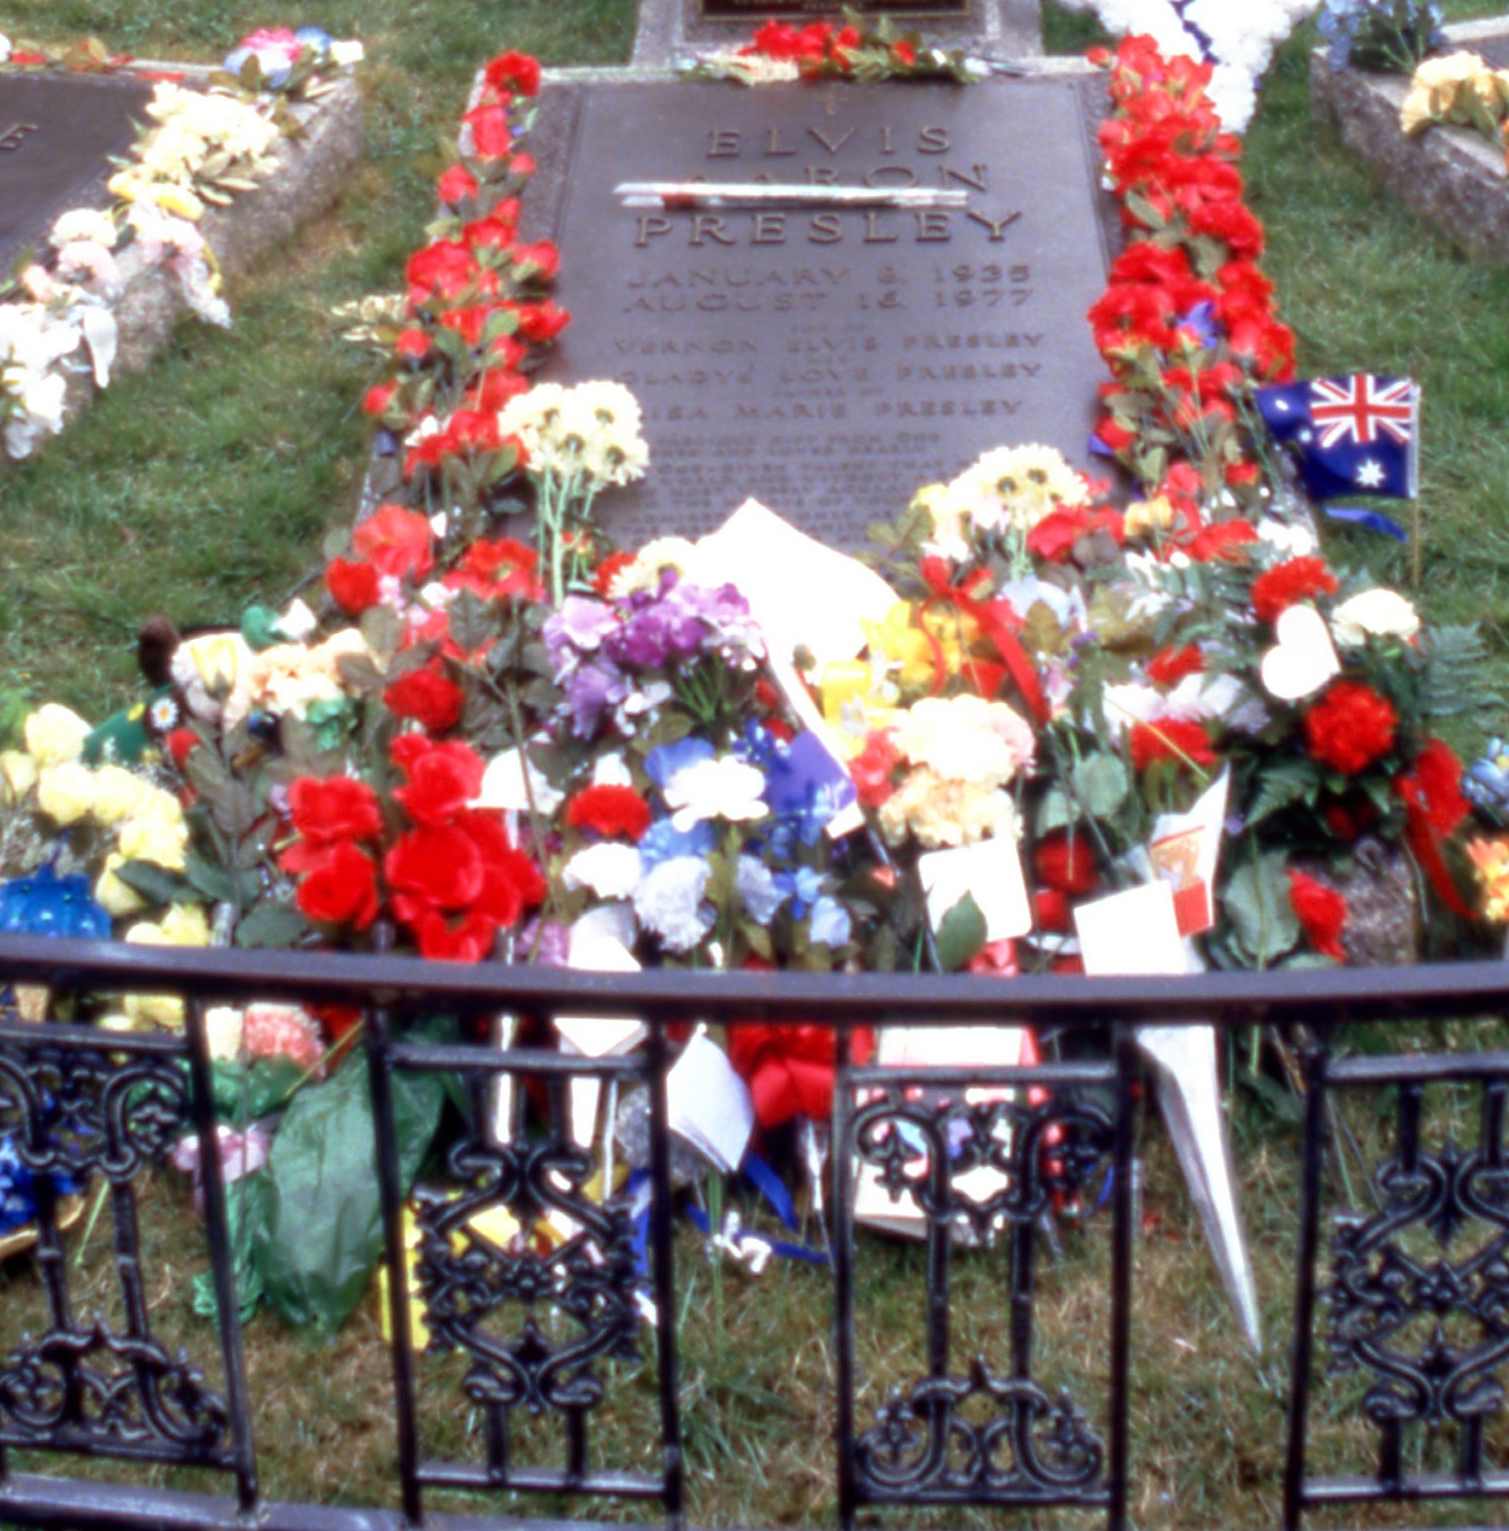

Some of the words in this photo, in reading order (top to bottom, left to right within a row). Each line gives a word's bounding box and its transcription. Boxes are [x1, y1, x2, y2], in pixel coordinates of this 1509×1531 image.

[706, 126, 951, 157] ELVIS
[634, 212, 1021, 247] PRESLEY
[628, 268, 852, 289] JANUARY
[622, 292, 828, 313] AUGUST
[935, 289, 1034, 309] 1977
[614, 339, 758, 356] VERNON
[786, 336, 879, 355] ELVIS
[902, 333, 1045, 351] PRESLEY
[780, 367, 872, 384] LOVE
[897, 363, 1042, 381] PRESLEY
[644, 403, 709, 422] ISA
[734, 402, 848, 421] MARIE
[875, 400, 1024, 419] PRESLEY
